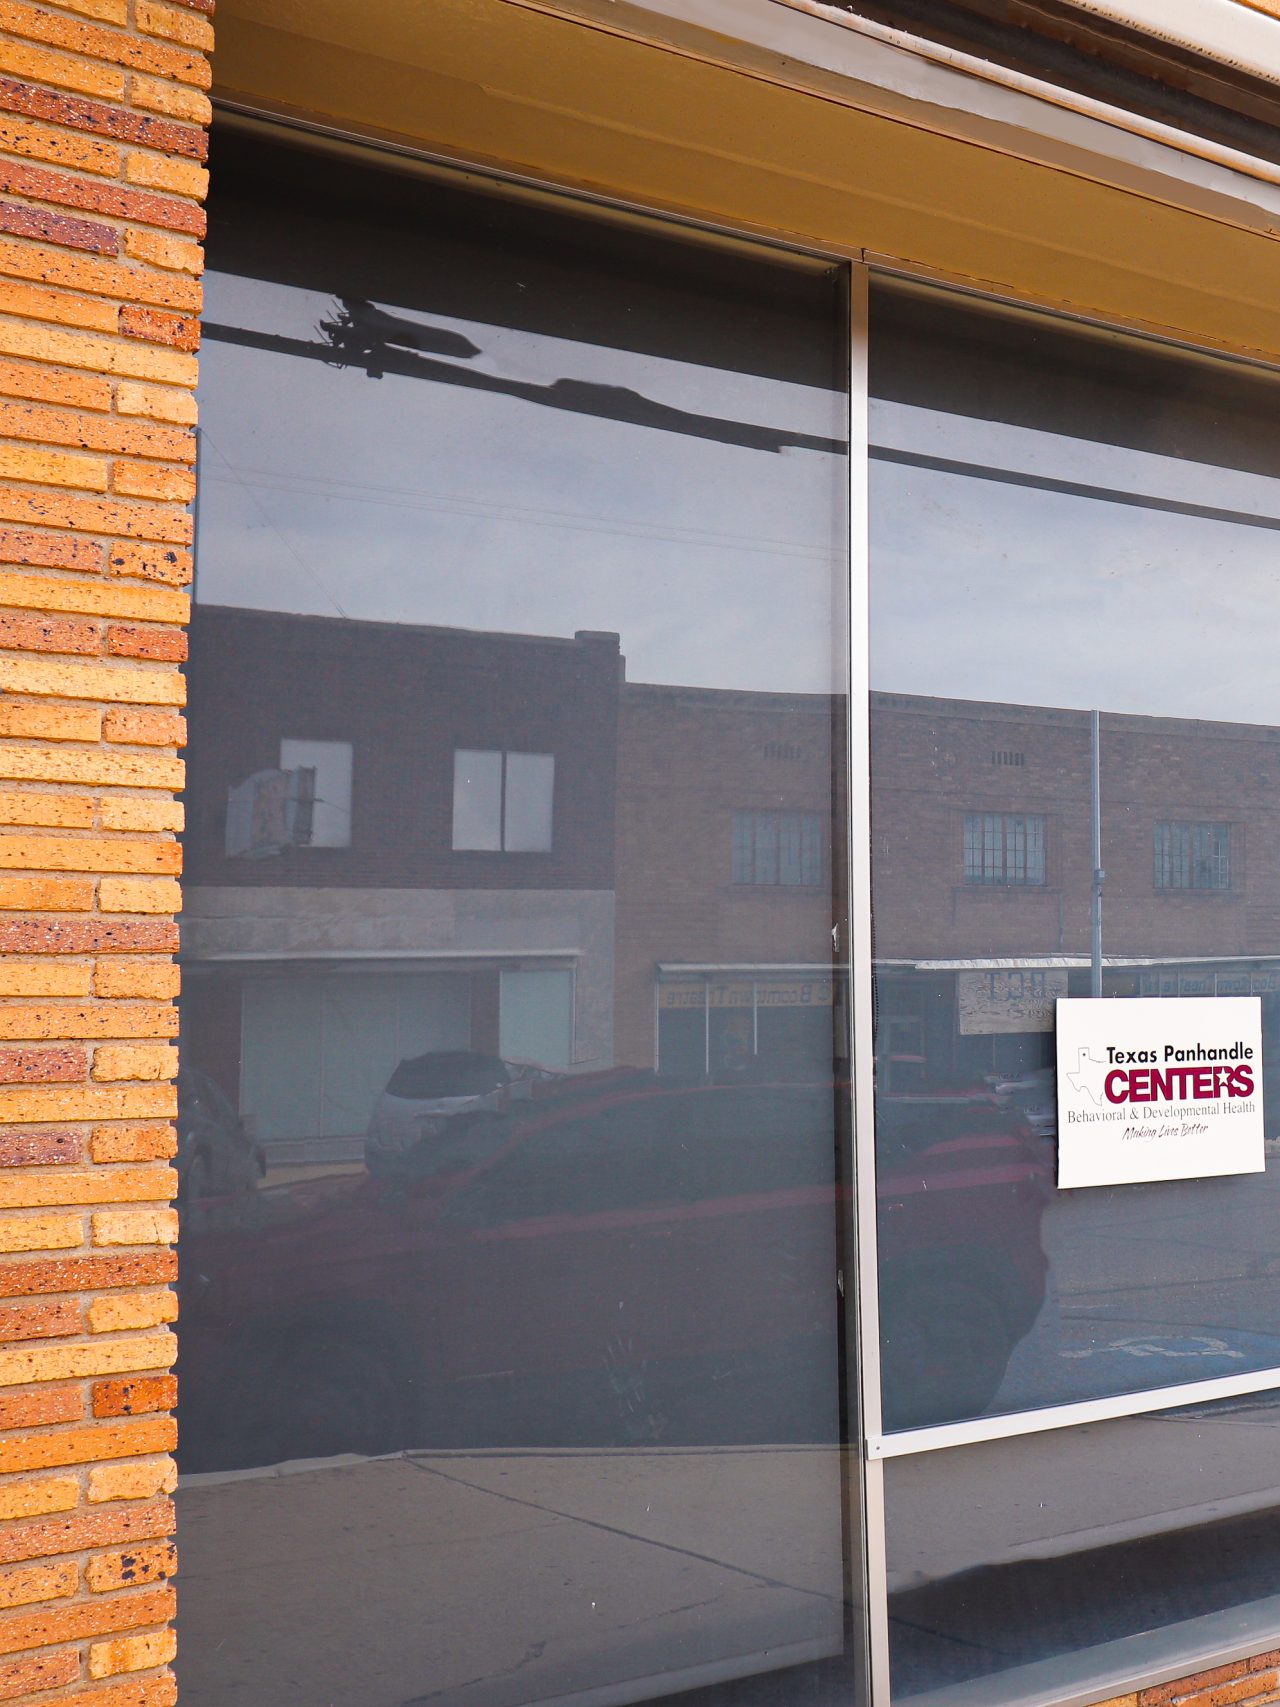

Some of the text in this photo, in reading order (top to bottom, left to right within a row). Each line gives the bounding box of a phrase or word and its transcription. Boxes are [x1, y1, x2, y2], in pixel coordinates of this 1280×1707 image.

[1106, 1041, 1254, 1064] Texas Panhandle
[1104, 1064, 1254, 1104] CENTERS
[1067, 1101, 1256, 1124] Behavioral & Developmental Health
[1122, 1123, 1209, 1141] Making Lives Better
